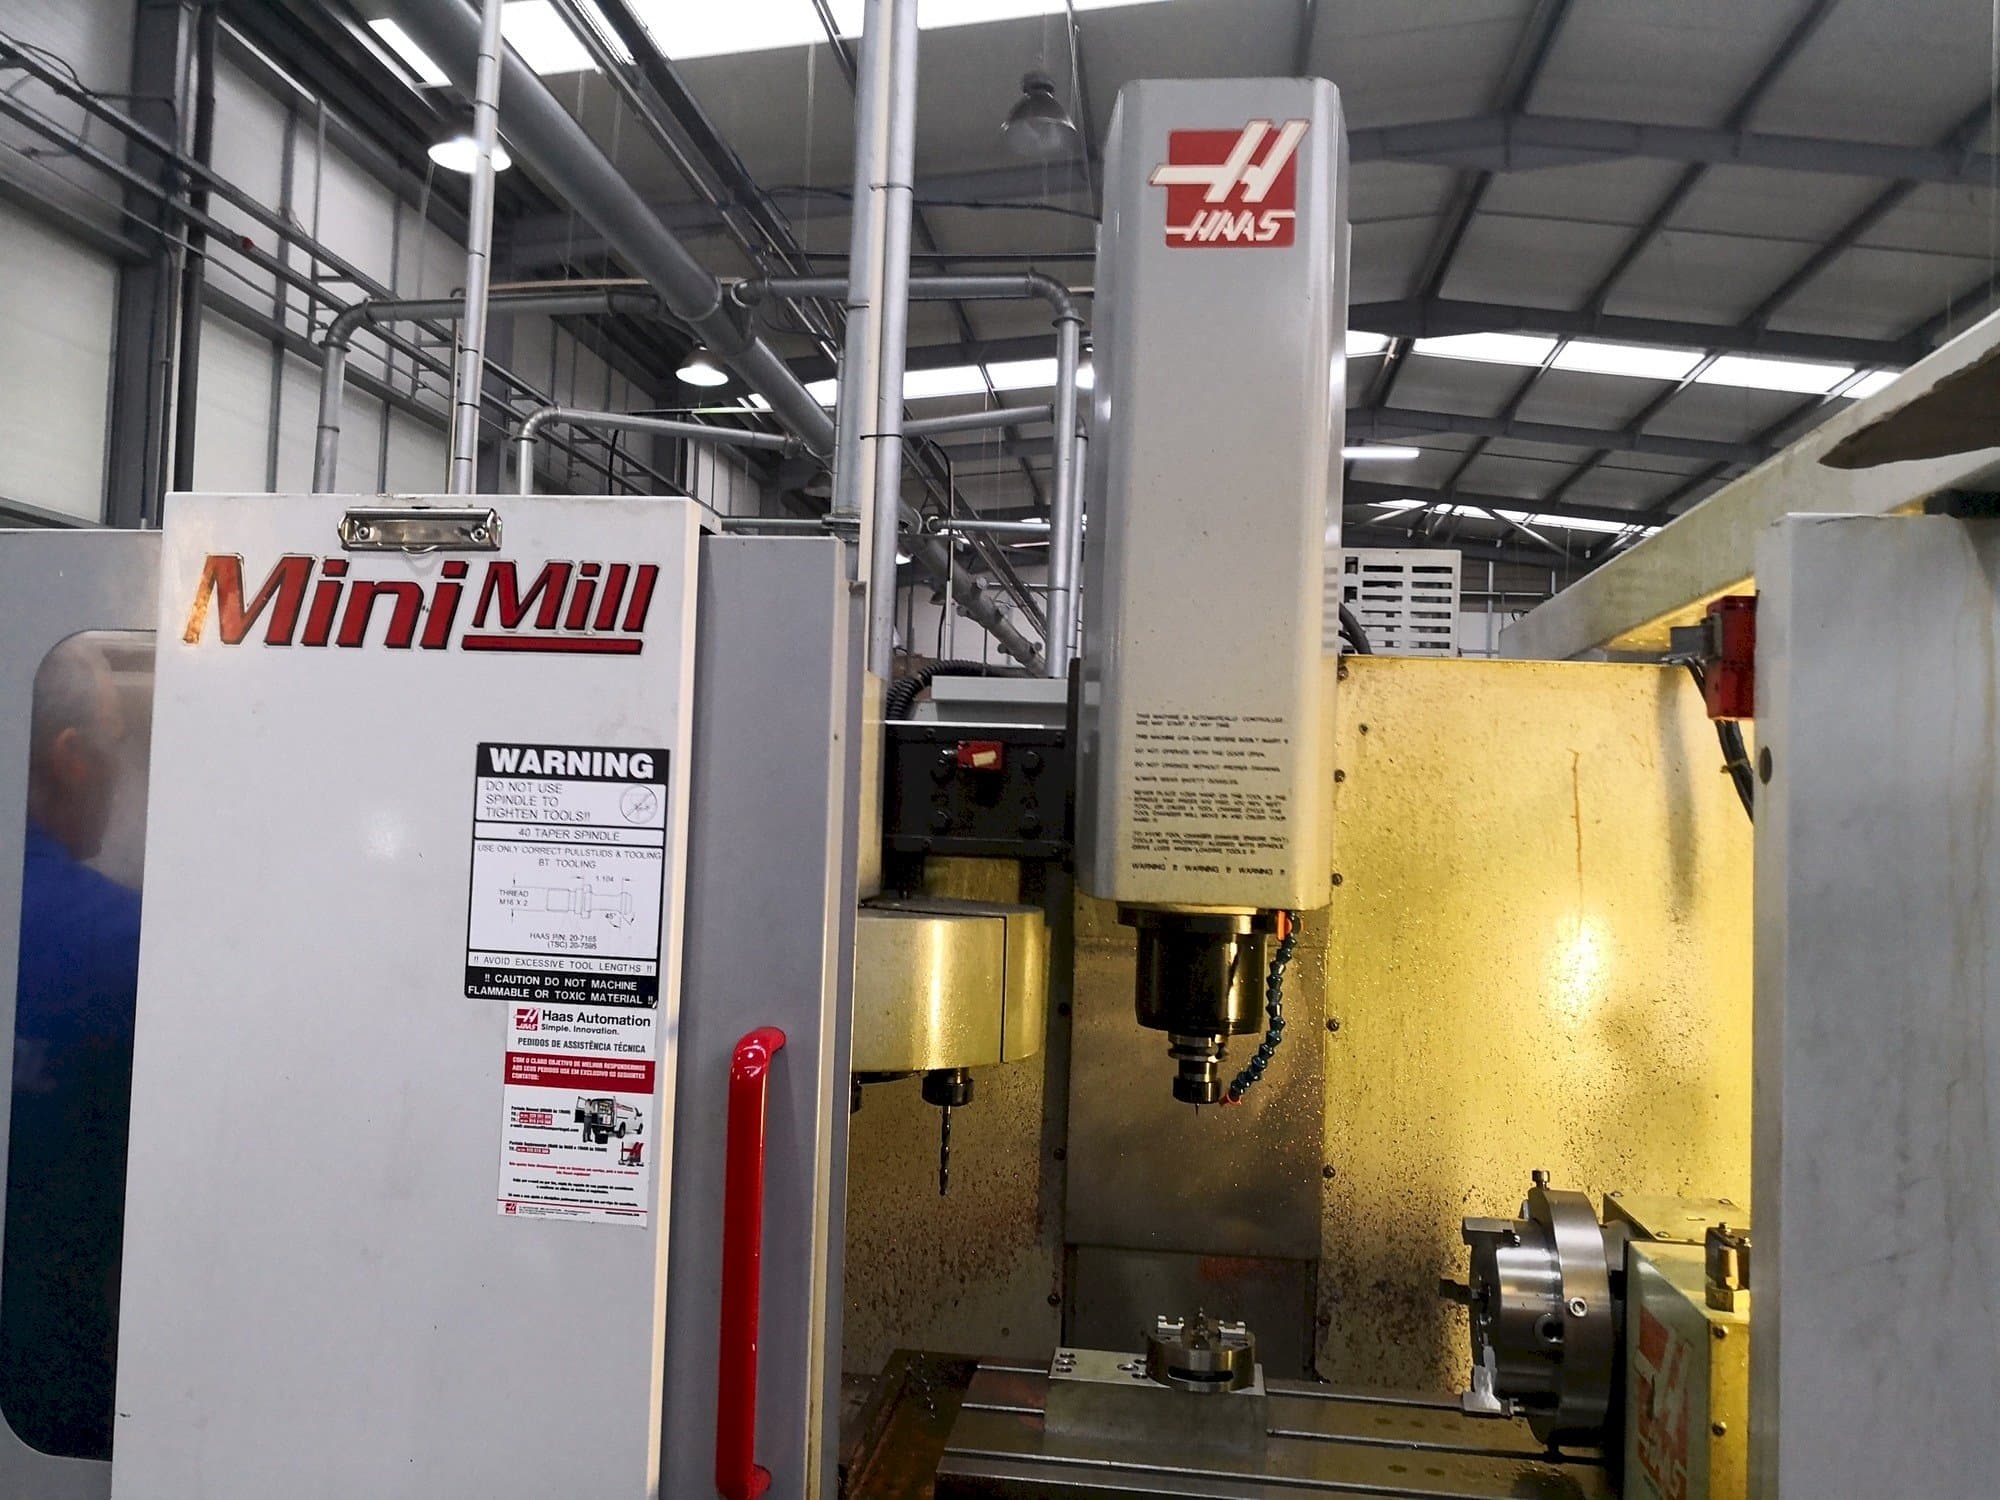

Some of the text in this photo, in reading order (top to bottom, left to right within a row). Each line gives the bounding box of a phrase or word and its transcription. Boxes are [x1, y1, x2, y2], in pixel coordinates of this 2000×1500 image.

[1166, 210, 1296, 242] HAAS
[490, 748, 654, 779] WARNING
[486, 781, 562, 794] DO NOT USE
[486, 795, 558, 807] SPINDLE TO
[486, 807, 590, 821] TIGHTEN TOOLS!!
[536, 830, 570, 839] TAPER
[574, 831, 620, 841] SPINDLE
[522, 847, 561, 855] CORRECT
[625, 851, 661, 860] TOOLING
[557, 860, 596, 869] TOOLING
[548, 941, 568, 949] (TSC)
[484, 957, 510, 966] AVOID
[515, 958, 565, 968] EXCESSIVE
[570, 961, 593, 970] TOOL
[600, 962, 641, 972] LENGTHS
[495, 974, 540, 985] CAUTION
[545, 977, 559, 986] DO
[565, 978, 587, 988] NOT
[591, 980, 637, 990] MACHINE
[468, 986, 529, 998] FLAMMABLE
[534, 989, 549, 999] OR
[555, 990, 586, 1000] TOXIC
[590, 993, 643, 1004] MATERIAL
[542, 1010, 651, 1026] Haas Automation
[541, 1024, 619, 1035] Simple. Innovation.
[518, 1037, 646, 1053] PEDIDOS DE ASSISTÊNCIA TÉCNICA
